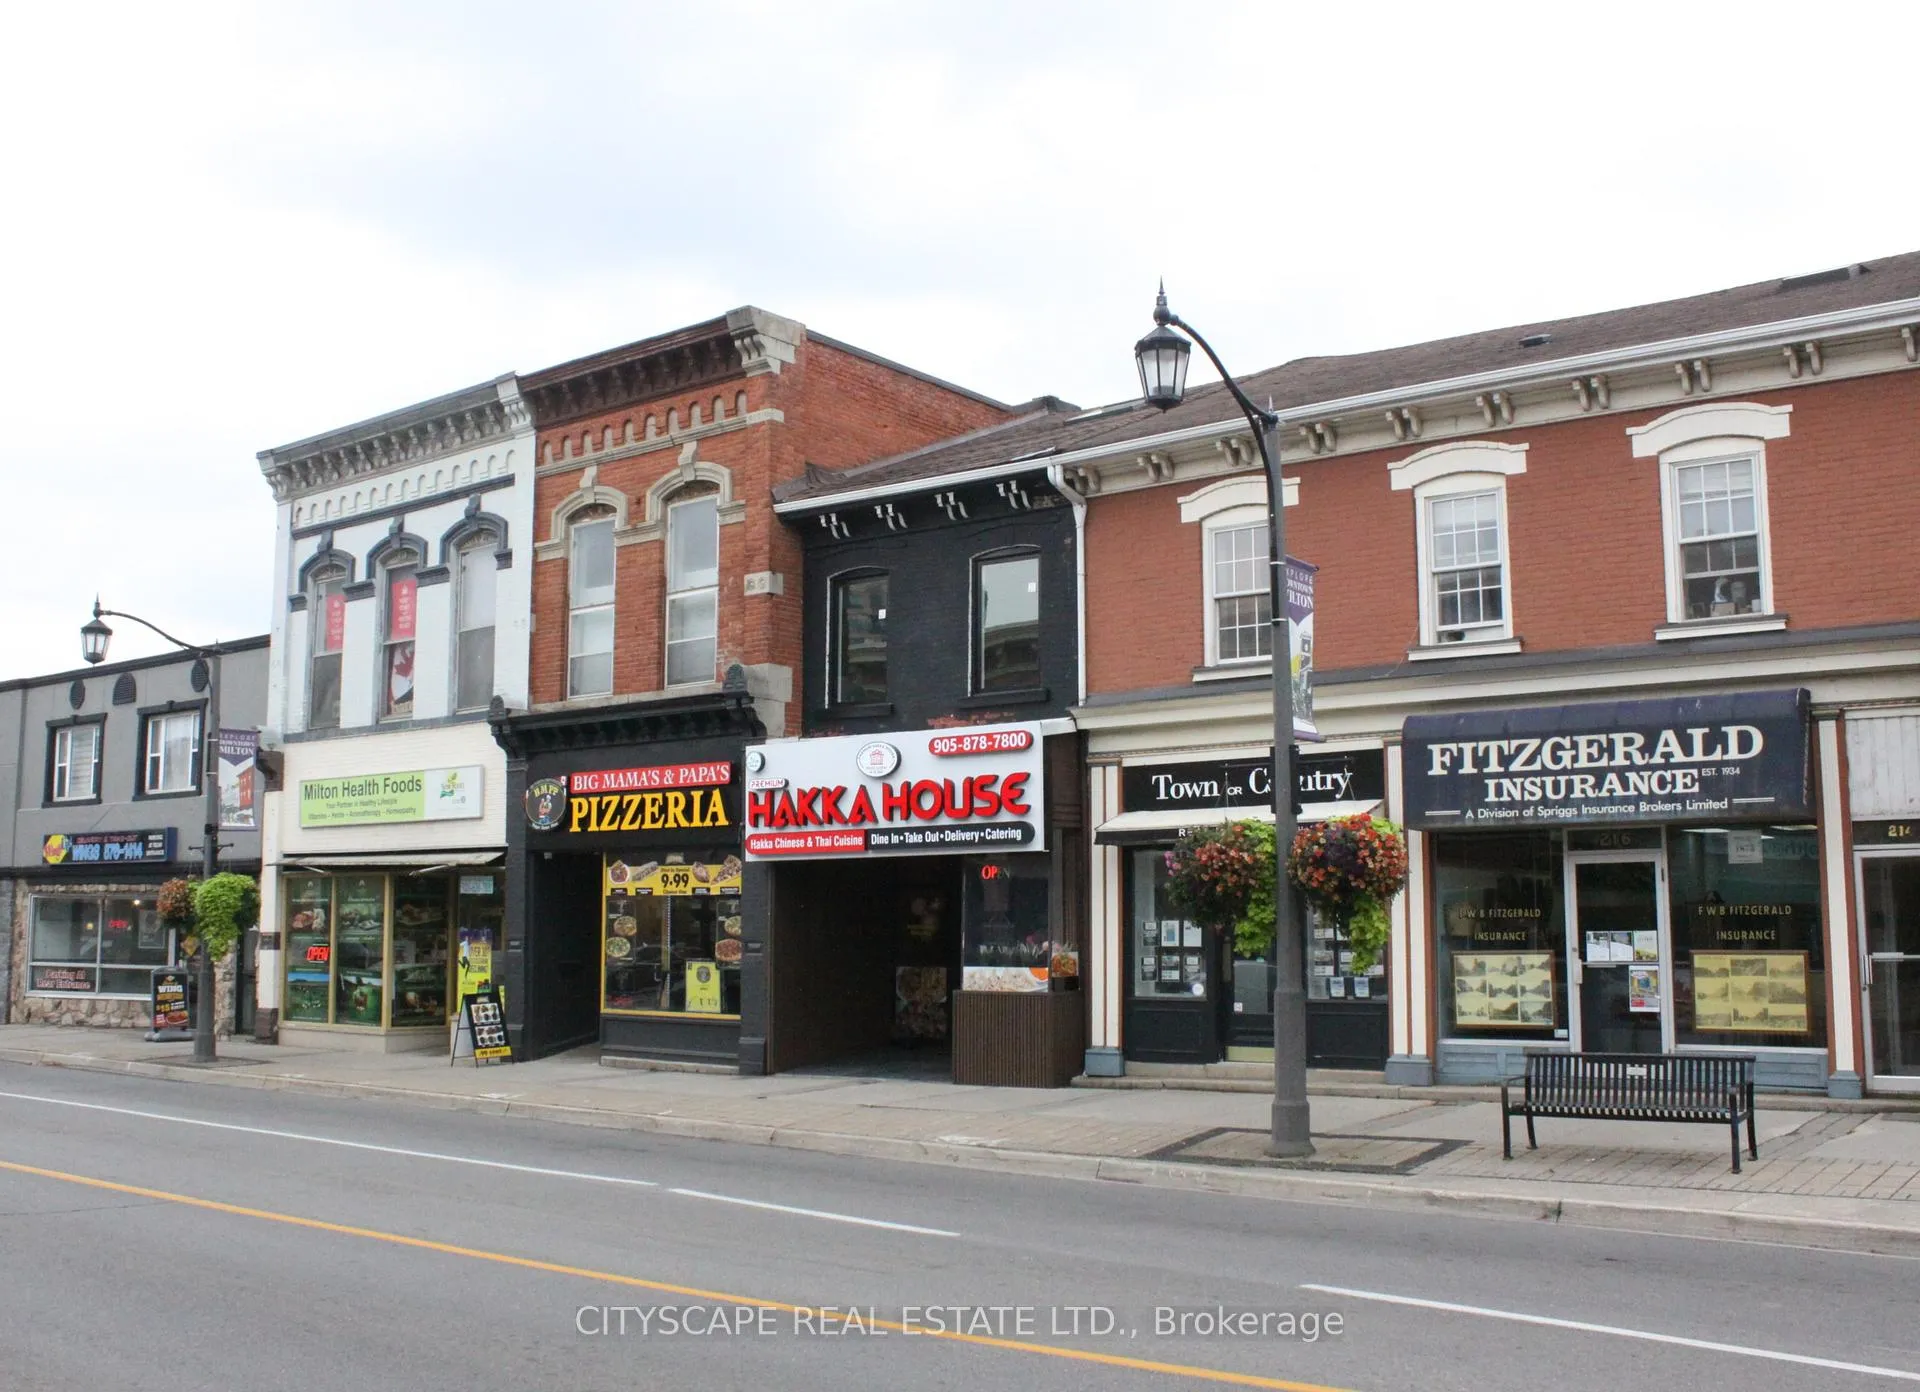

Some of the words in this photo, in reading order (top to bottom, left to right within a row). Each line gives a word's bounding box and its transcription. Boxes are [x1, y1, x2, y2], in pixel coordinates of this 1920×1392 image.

[1286, 589, 1314, 608] ILTON
[219, 746, 254, 756] MILTON
[934, 732, 1026, 753] 905-878-7800
[1427, 725, 1764, 776] FITZGERALD
[574, 774, 598, 790] BIG
[602, 770, 660, 788] MAMA'S
[664, 769, 674, 784] &
[680, 765, 730, 784] PAPA'S
[751, 779, 784, 788] PREMIUM
[1152, 774, 1220, 800] Town
[1226, 786, 1242, 796] OR
[1248, 768, 1353, 798] Cntry
[1484, 769, 1700, 802] INSURANCE
[1702, 768, 1718, 776] EST.
[1722, 767, 1740, 776] 1934
[304, 784, 338, 800] Milton
[342, 780, 379, 798] Health
[384, 776, 422, 794] Foods
[748, 784, 878, 828] HAKKA
[882, 772, 1031, 822] HOUSE
[1465, 810, 1474, 818] A
[1478, 808, 1518, 818] Division
[1522, 806, 1534, 816] of
[1538, 806, 1578, 818] Spriggs
[1582, 803, 1635, 815] Insurance
[1639, 801, 1682, 812] Brokers
[1686, 798, 1728, 810] Limited
[569, 788, 729, 832] PIZZERIA
[750, 839, 772, 849] Hakka
[774, 837, 804, 848] Chinese
[806, 836, 812, 847] &
[815, 836, 832, 846] Thai
[834, 835, 862, 846] Cuisine
[871, 833, 888, 844] Dine
[891, 832, 899, 844] In
[904, 832, 923, 843] Take
[925, 832, 939, 842] Out
[945, 829, 980, 843] Delivery
[986, 828, 1022, 841] Catering
[1600, 832, 1631, 846] 216
[1467, 909, 1476, 918] W
[1489, 908, 1541, 918] FITZGERALD
[1698, 906, 1703, 915] F
[1706, 906, 1716, 915] W
[1720, 906, 1725, 915] B
[1730, 905, 1792, 916] FITZGERALD
[1474, 932, 1526, 941] INSURANCE
[1716, 930, 1776, 940] INSURANCE
[307, 946, 329, 961] OPEN
